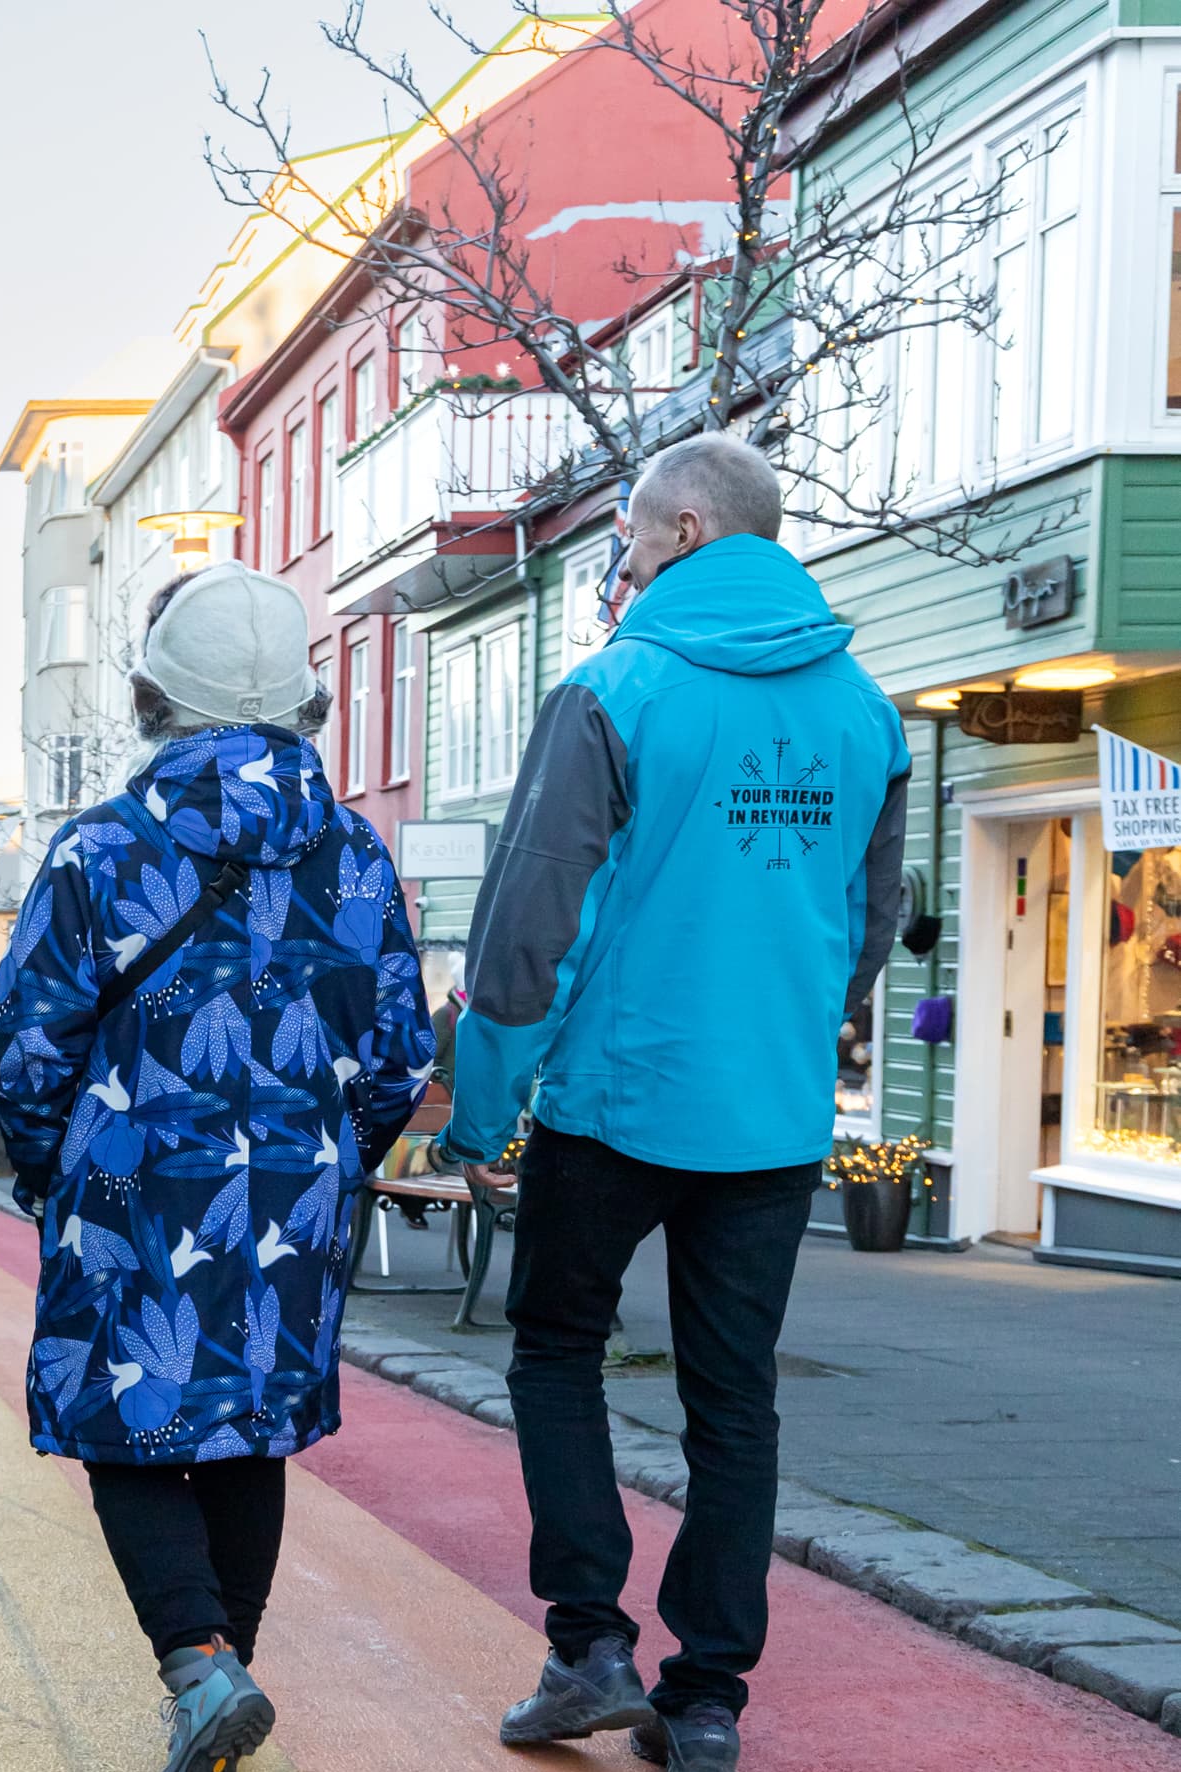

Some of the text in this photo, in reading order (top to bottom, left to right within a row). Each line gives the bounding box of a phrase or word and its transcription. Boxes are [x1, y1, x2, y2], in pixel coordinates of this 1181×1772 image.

[731, 789, 834, 805] YOUR FRIEND
[1113, 796, 1180, 817] TAX FREE
[728, 806, 833, 827] IN REYKJAVÍK
[1114, 818, 1181, 837] SHOPPING
[410, 840, 476, 857] Kaolin
